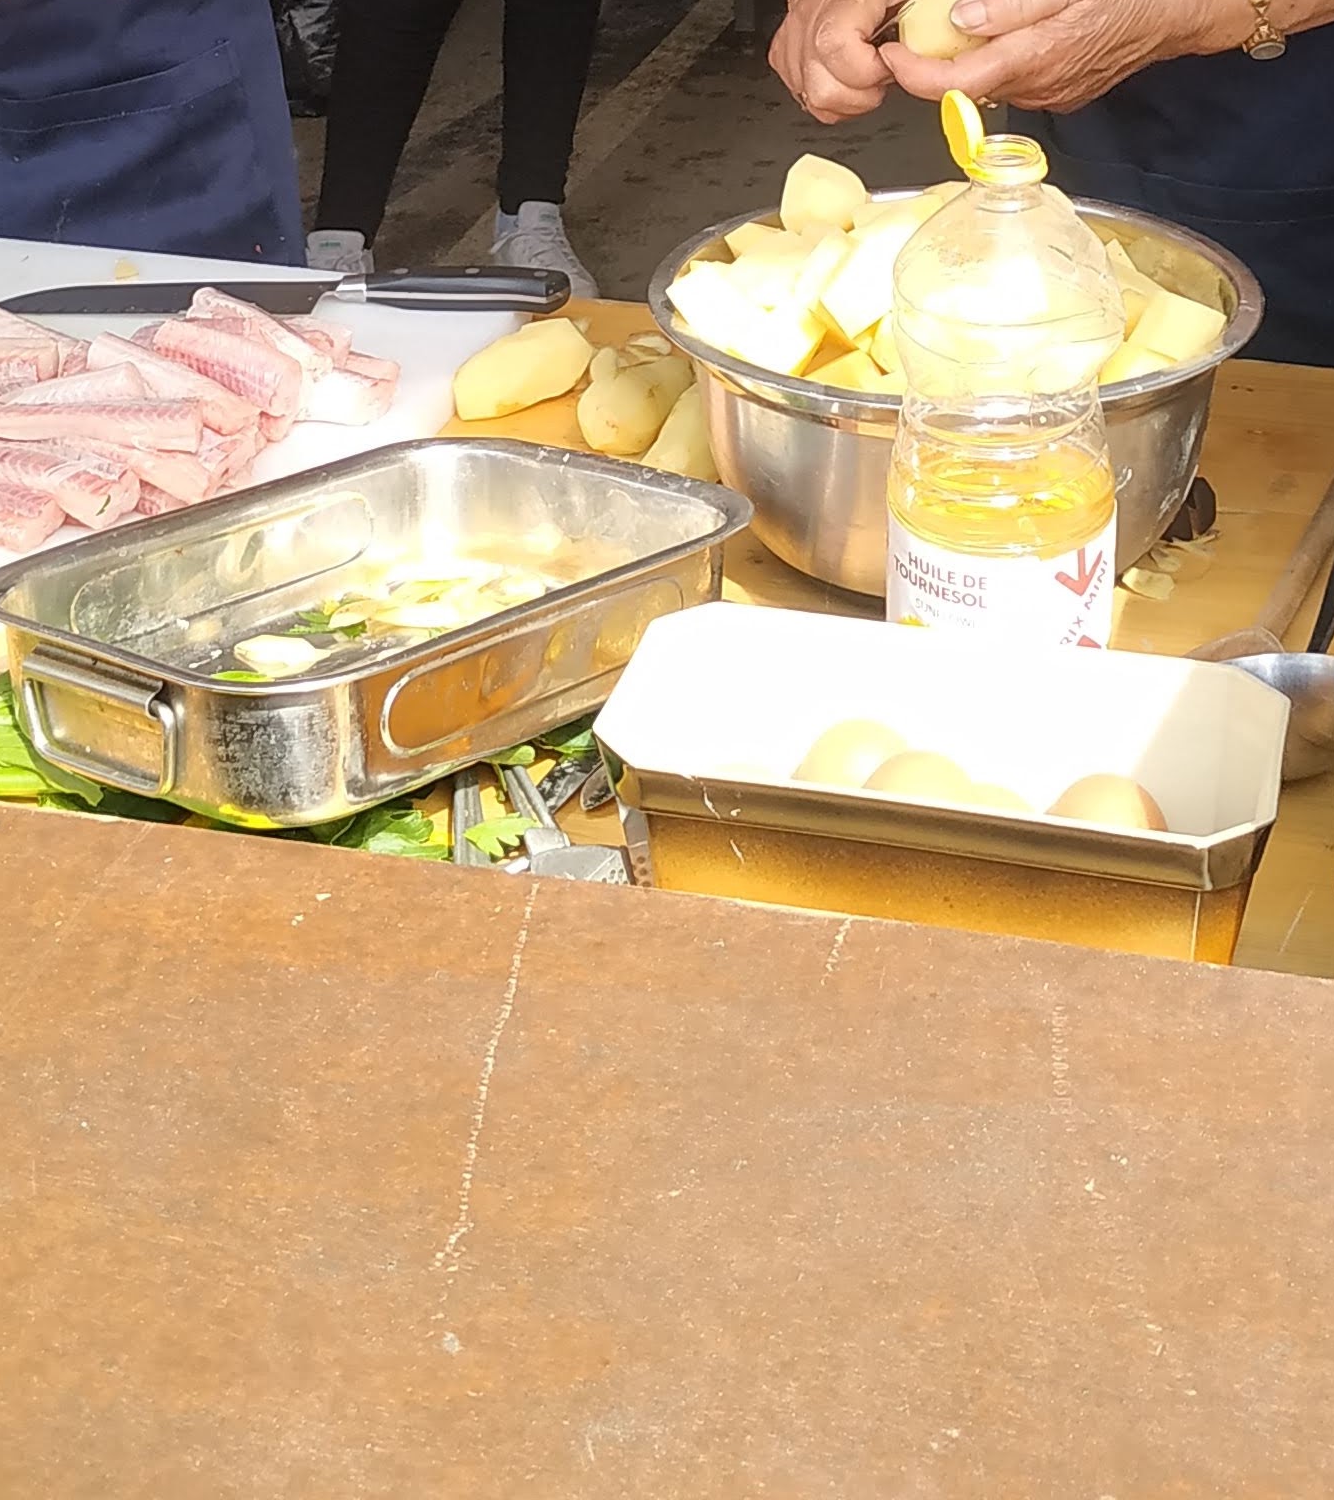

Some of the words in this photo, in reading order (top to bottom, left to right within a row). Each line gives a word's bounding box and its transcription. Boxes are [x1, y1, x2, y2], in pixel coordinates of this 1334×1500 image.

[893, 554, 988, 609] TOURNESOL
[908, 551, 957, 585] HUILE
[963, 574, 988, 591] DE
[1059, 615, 1084, 645] RIX
